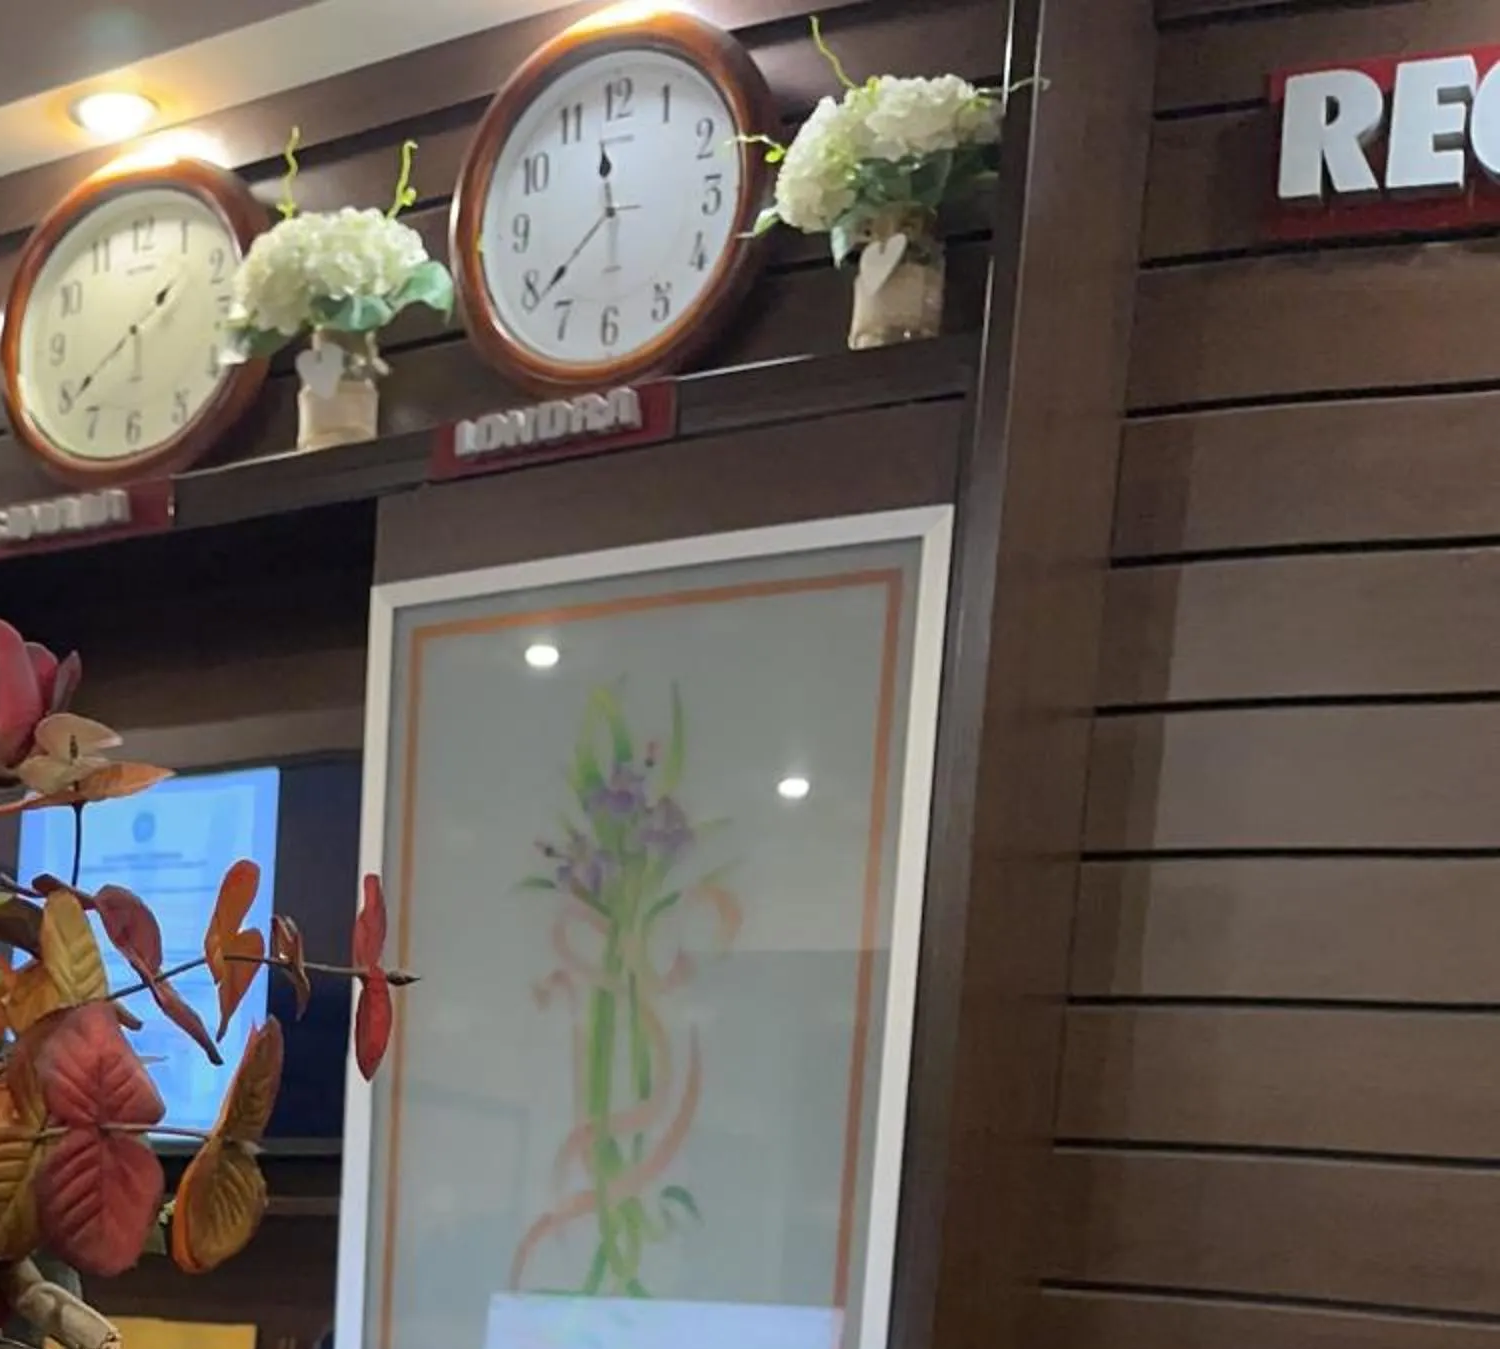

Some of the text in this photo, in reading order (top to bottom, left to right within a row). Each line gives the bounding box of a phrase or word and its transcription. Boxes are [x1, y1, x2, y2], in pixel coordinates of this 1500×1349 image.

[604, 77, 634, 121] 12
[661, 83, 670, 124] 1
[560, 102, 583, 145] 11
[696, 116, 714, 160] 2
[524, 151, 549, 195] 10
[702, 173, 722, 216] 3
[132, 215, 155, 254] 12
[181, 219, 188, 255] 1
[512, 213, 530, 253] 9
[689, 231, 707, 271] 4
[91, 238, 111, 275] 11
[209, 248, 225, 285] 2
[61, 279, 83, 319] 10
[521, 269, 540, 314] 8
[651, 281, 673, 322] 5
[554, 299, 575, 341] 7
[601, 305, 619, 346] 6
[50, 332, 65, 367] 9
[58, 379, 75, 416] 8
[170, 388, 191, 425] 5
[84, 404, 101, 441] 7
[126, 410, 142, 446] 6
[455, 385, 643, 458] LONDRA
